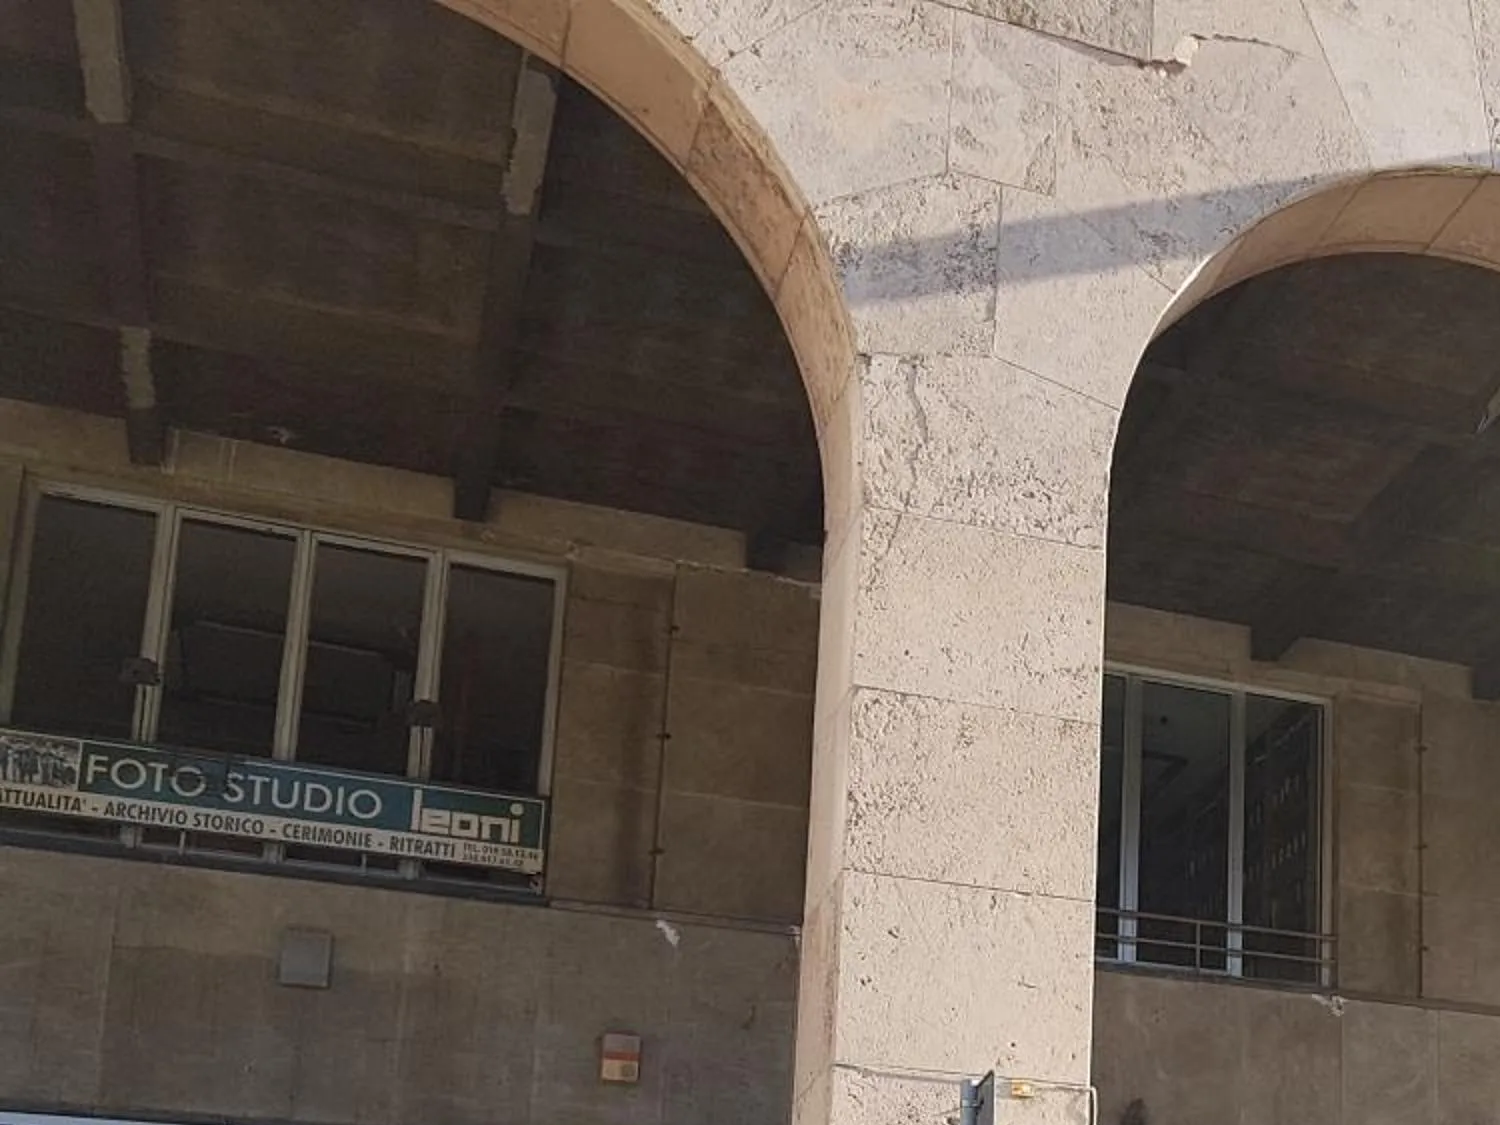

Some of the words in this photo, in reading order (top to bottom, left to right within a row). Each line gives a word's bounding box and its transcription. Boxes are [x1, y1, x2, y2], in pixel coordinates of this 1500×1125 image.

[86, 753, 207, 797] FOTO
[222, 770, 383, 820] STUDIO
[103, 801, 188, 827] ARCHIVIO
[191, 812, 265, 836] STORICO
[282, 822, 373, 849] CERIMONIE
[389, 835, 456, 859] RITRATTI
